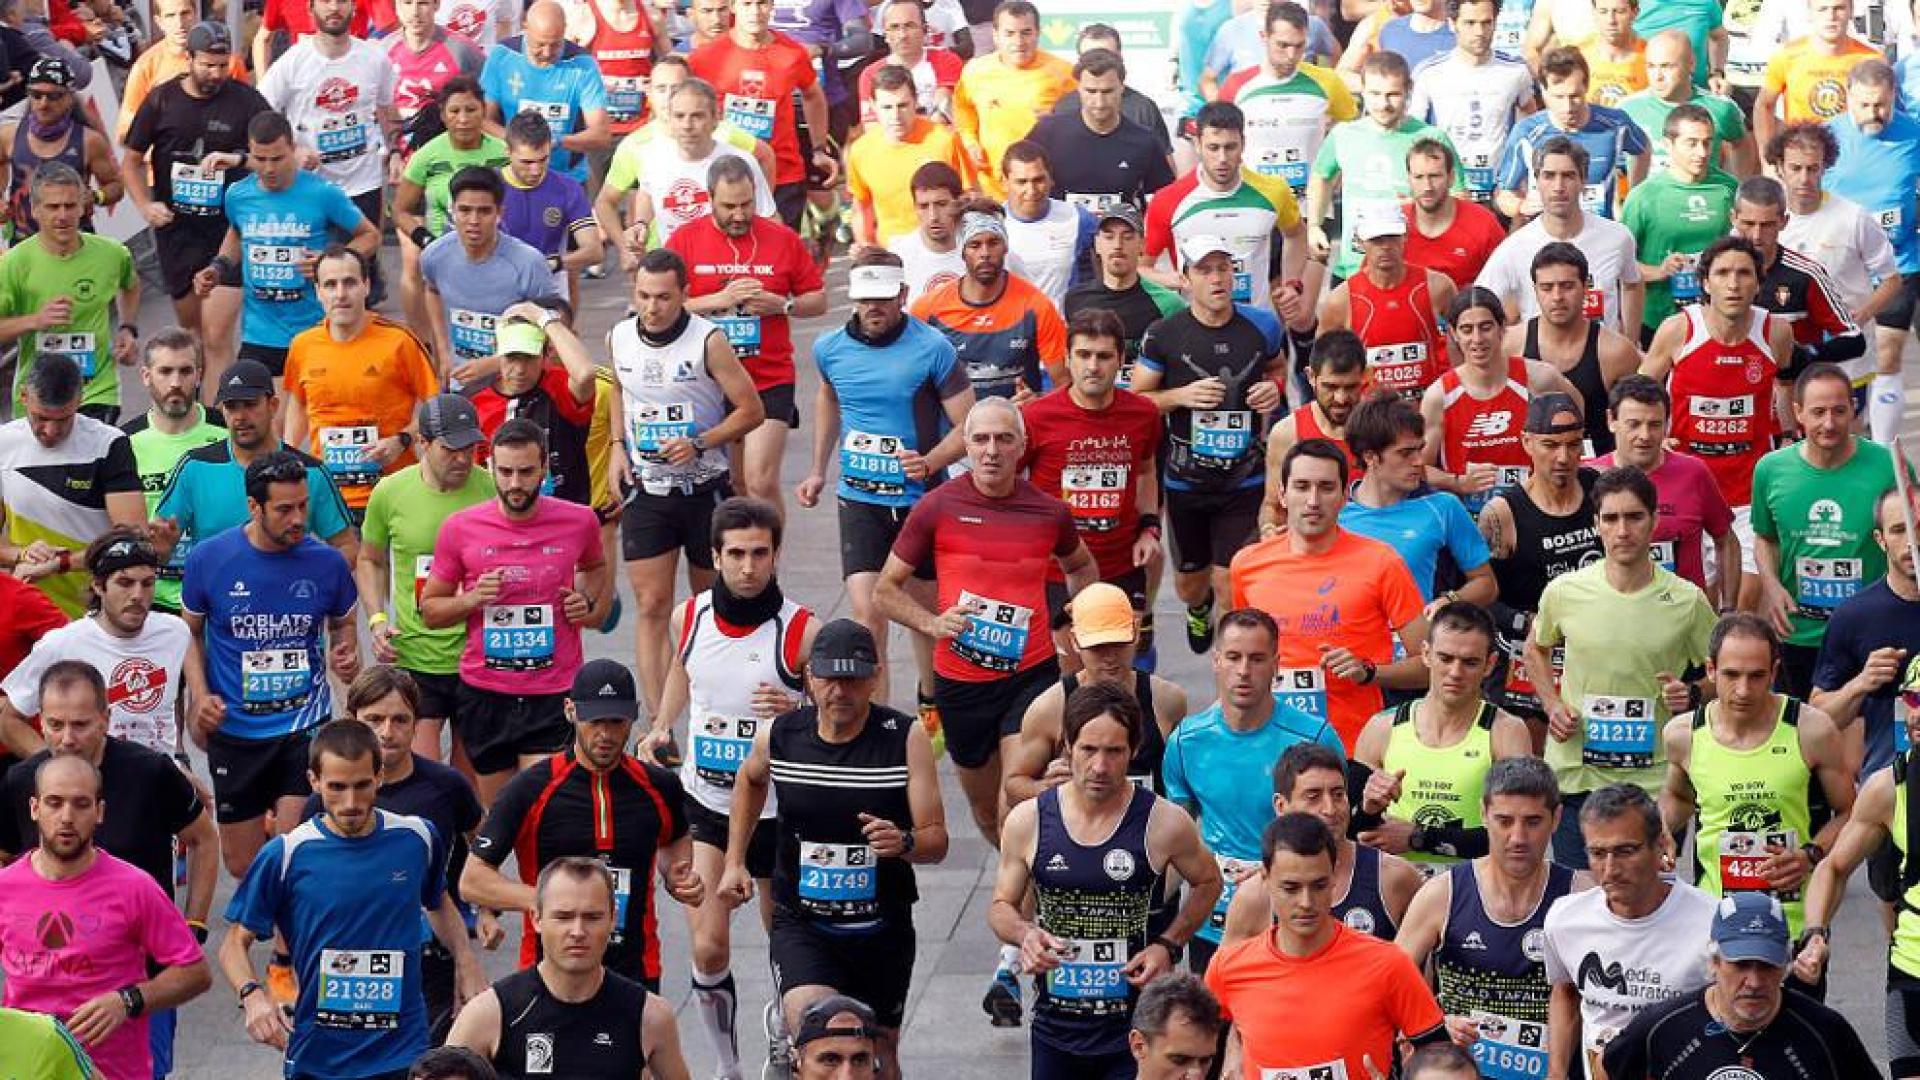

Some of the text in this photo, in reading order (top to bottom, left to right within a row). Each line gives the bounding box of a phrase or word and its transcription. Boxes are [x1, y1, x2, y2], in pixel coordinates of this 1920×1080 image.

[728, 321, 757, 338] 139
[327, 449, 363, 465] 2102
[849, 454, 900, 474] 21818
[1068, 492, 1120, 509] 42162
[1801, 582, 1856, 599] 21415
[232, 613, 313, 628] POBLATS
[968, 621, 1012, 647] 1400
[490, 631, 549, 659] 21334
[1588, 723, 1649, 742] 21217
[701, 740, 746, 761] 2181
[806, 872, 869, 889] 21749
[1054, 967, 1120, 987] 21329
[327, 980, 394, 1000] 21328
[1473, 1042, 1543, 1076] 21690
